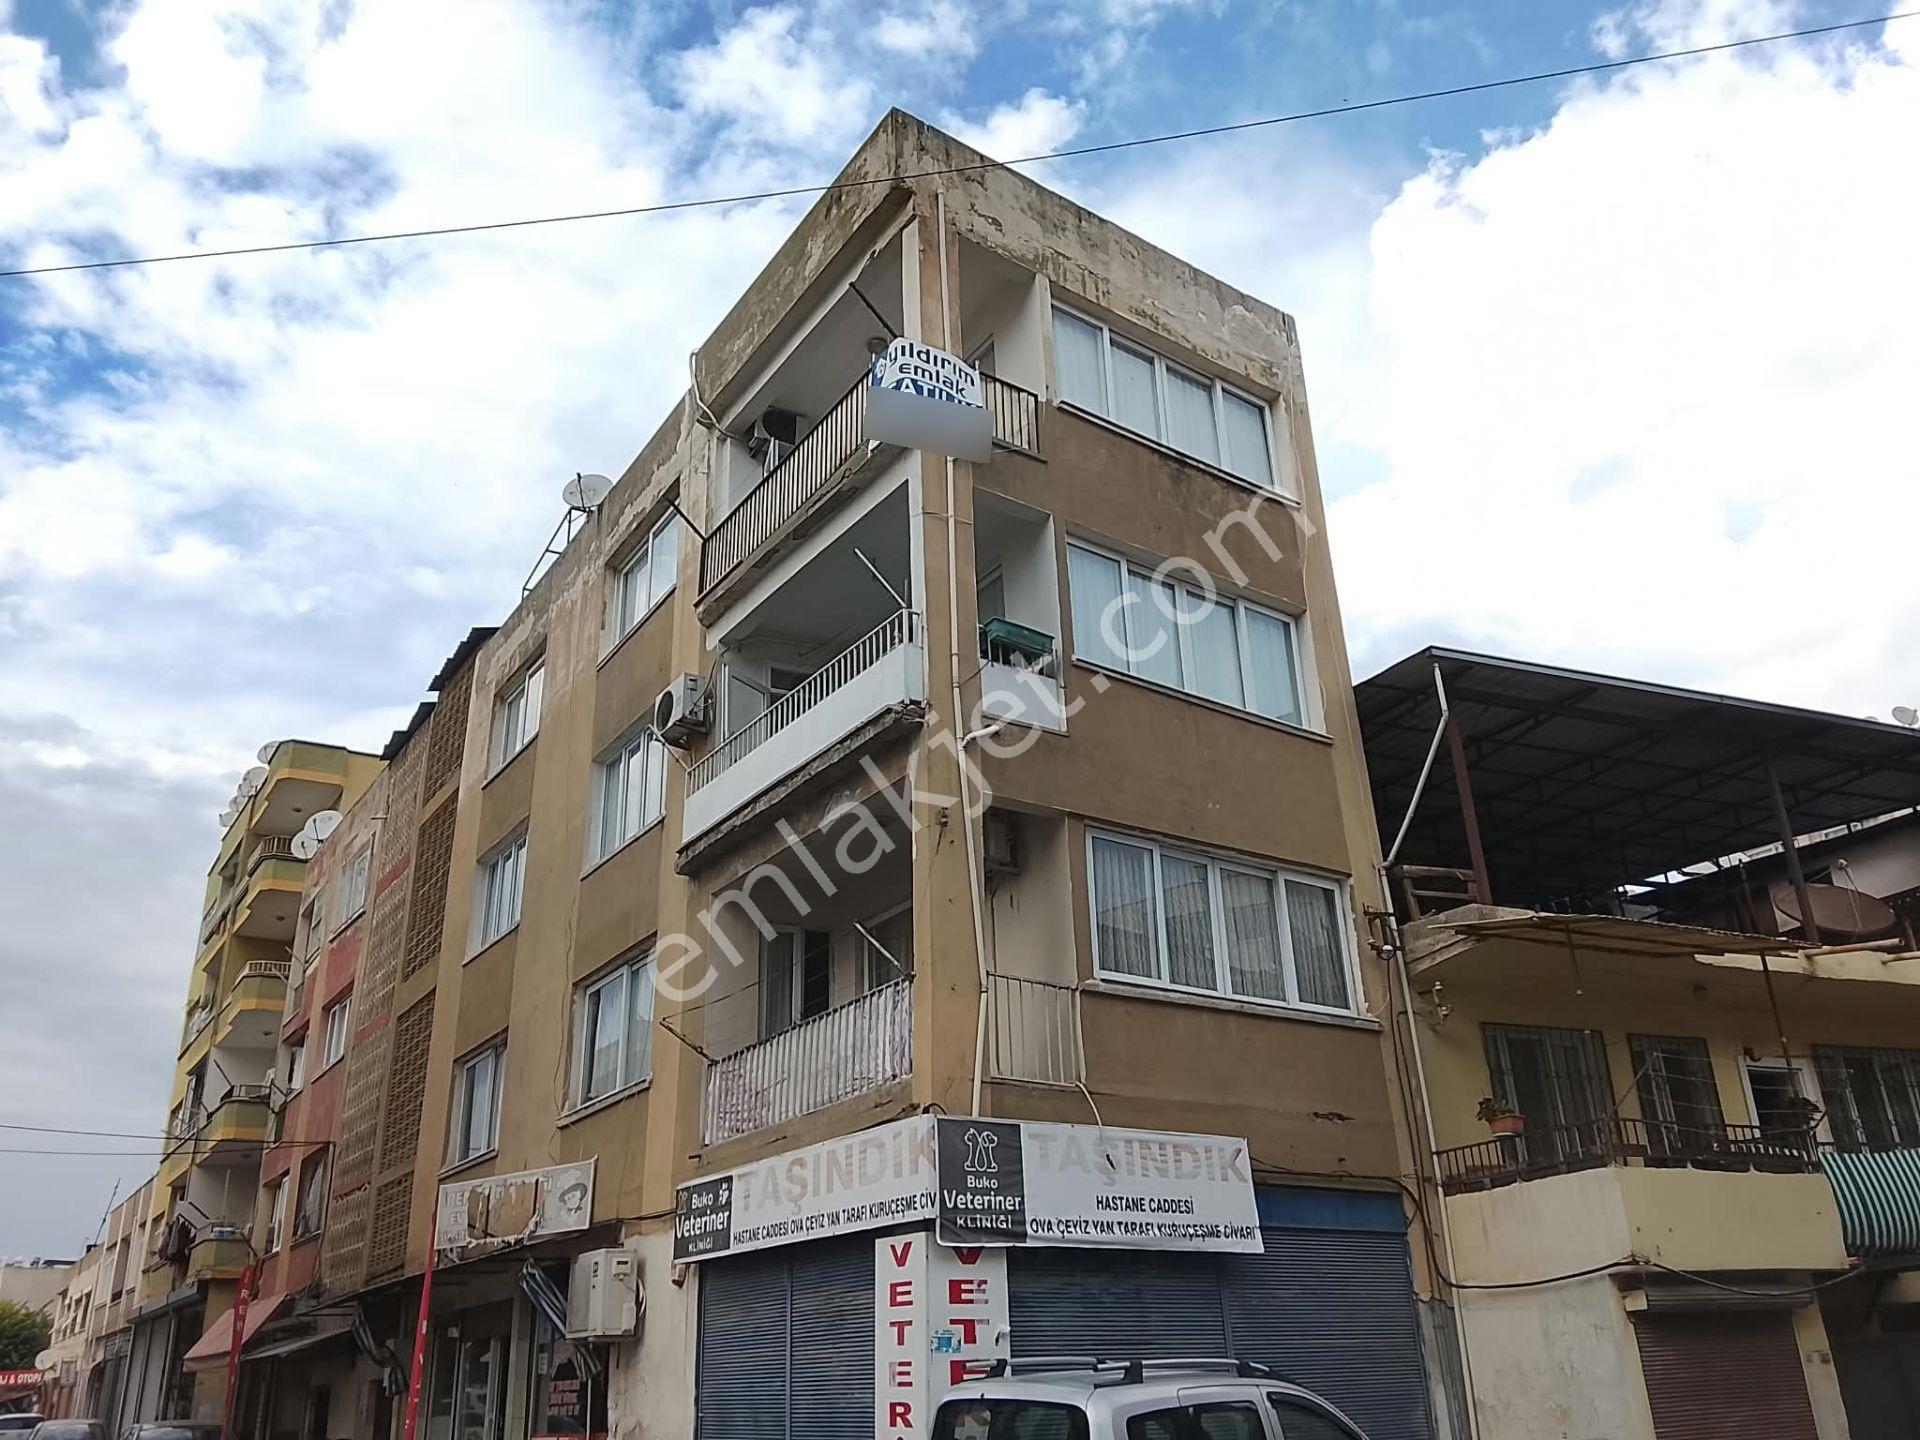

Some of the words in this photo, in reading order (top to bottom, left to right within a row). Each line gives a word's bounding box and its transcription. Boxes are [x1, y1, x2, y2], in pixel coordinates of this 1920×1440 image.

[899, 363, 967, 400] emlak
[967, 1175, 999, 1189] Buko
[692, 1192, 713, 1209] Buko
[944, 1189, 1022, 1211] Veteriner
[1096, 1195, 1147, 1213] HASTANE
[1149, 1194, 1194, 1215] CADDESİ
[676, 1209, 729, 1239] Veteriner
[733, 1226, 760, 1245] HASTANE
[790, 1216, 804, 1235] OVA
[826, 1208, 841, 1228] YAN
[1030, 1218, 1055, 1235] OVA
[1056, 1216, 1091, 1238] ÇEYİZ
[1092, 1220, 1116, 1236] YAN
[889, 1241, 913, 1440] VETER
